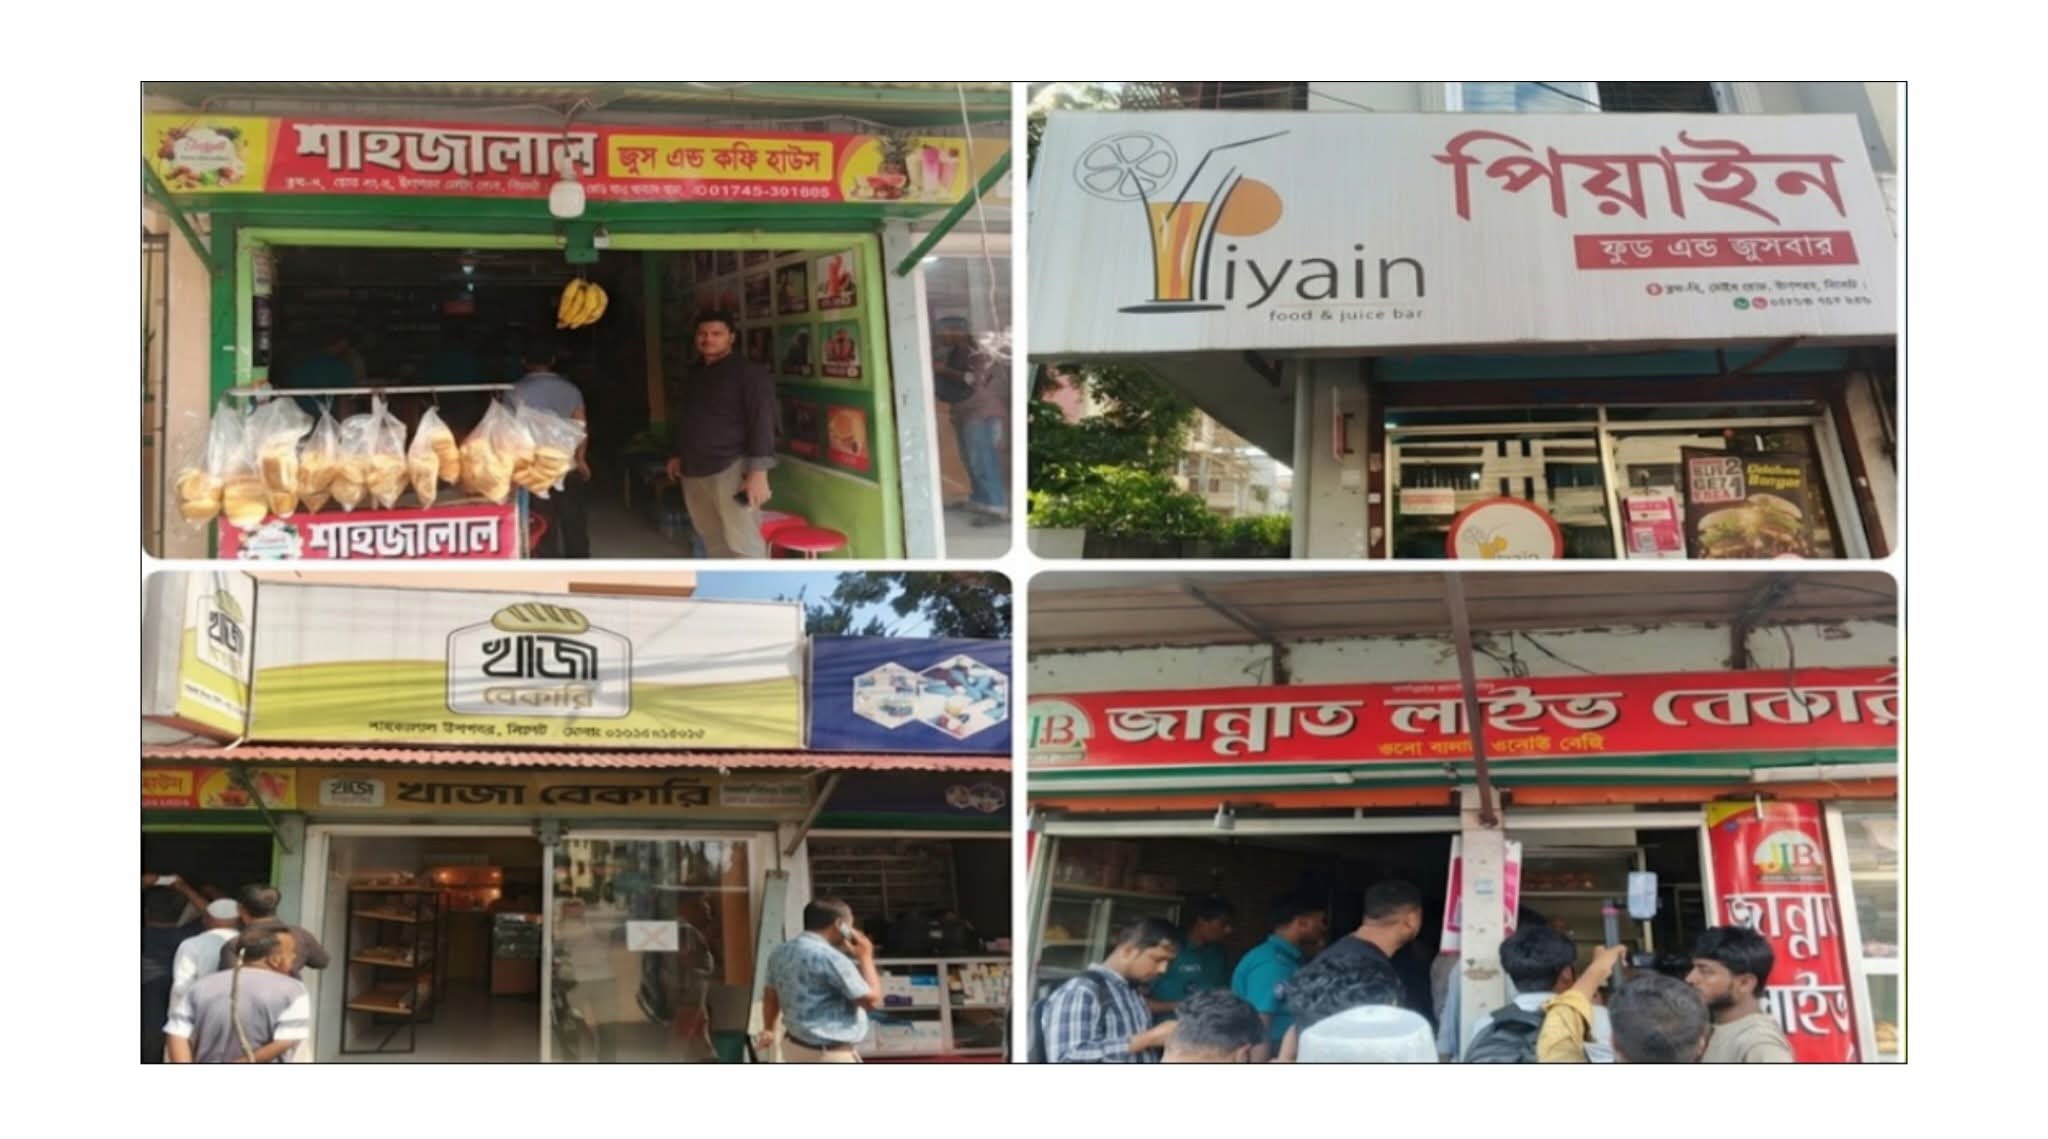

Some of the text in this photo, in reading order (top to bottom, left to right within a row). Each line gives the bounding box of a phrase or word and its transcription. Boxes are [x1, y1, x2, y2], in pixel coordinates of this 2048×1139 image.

[293, 123, 598, 177] শাহজালাল
[616, 146, 657, 175] জুস
[711, 141, 758, 171] কফি
[765, 144, 821, 175] হাউস
[1431, 129, 1849, 226] পিয়াইন
[1600, 240, 1653, 266] ফুড
[1269, 309, 1313, 321] food
[1339, 309, 1386, 324] juice
[1393, 308, 1424, 320] bar
[307, 516, 500, 558] শাহজালাল
[481, 635, 598, 681] খাজা
[1104, 700, 1366, 757] জান্নাত
[1652, 672, 1899, 727] বেকার
[397, 780, 529, 804] খাজা
